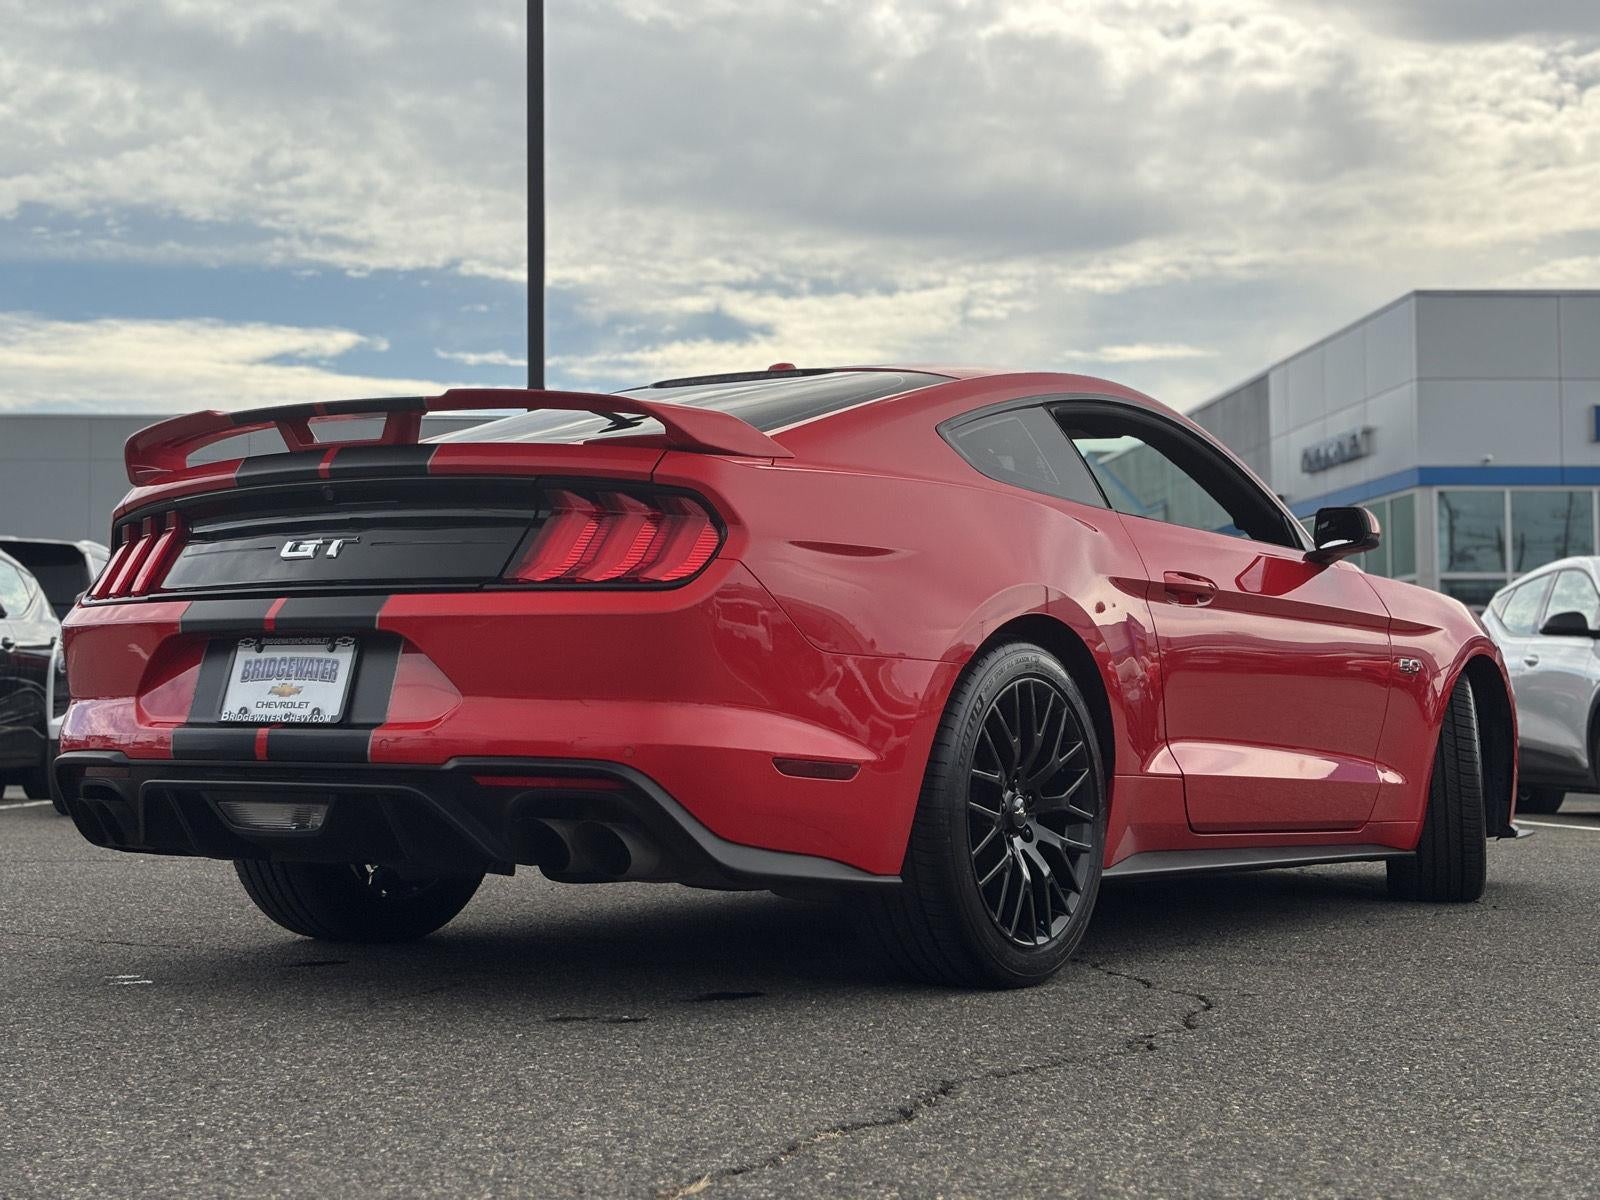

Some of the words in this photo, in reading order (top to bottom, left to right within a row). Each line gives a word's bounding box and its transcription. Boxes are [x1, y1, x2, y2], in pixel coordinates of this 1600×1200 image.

[280, 537, 360, 561] GT
[240, 656, 340, 683] BRIDGEWATER
[256, 701, 310, 709] CHEVROLET
